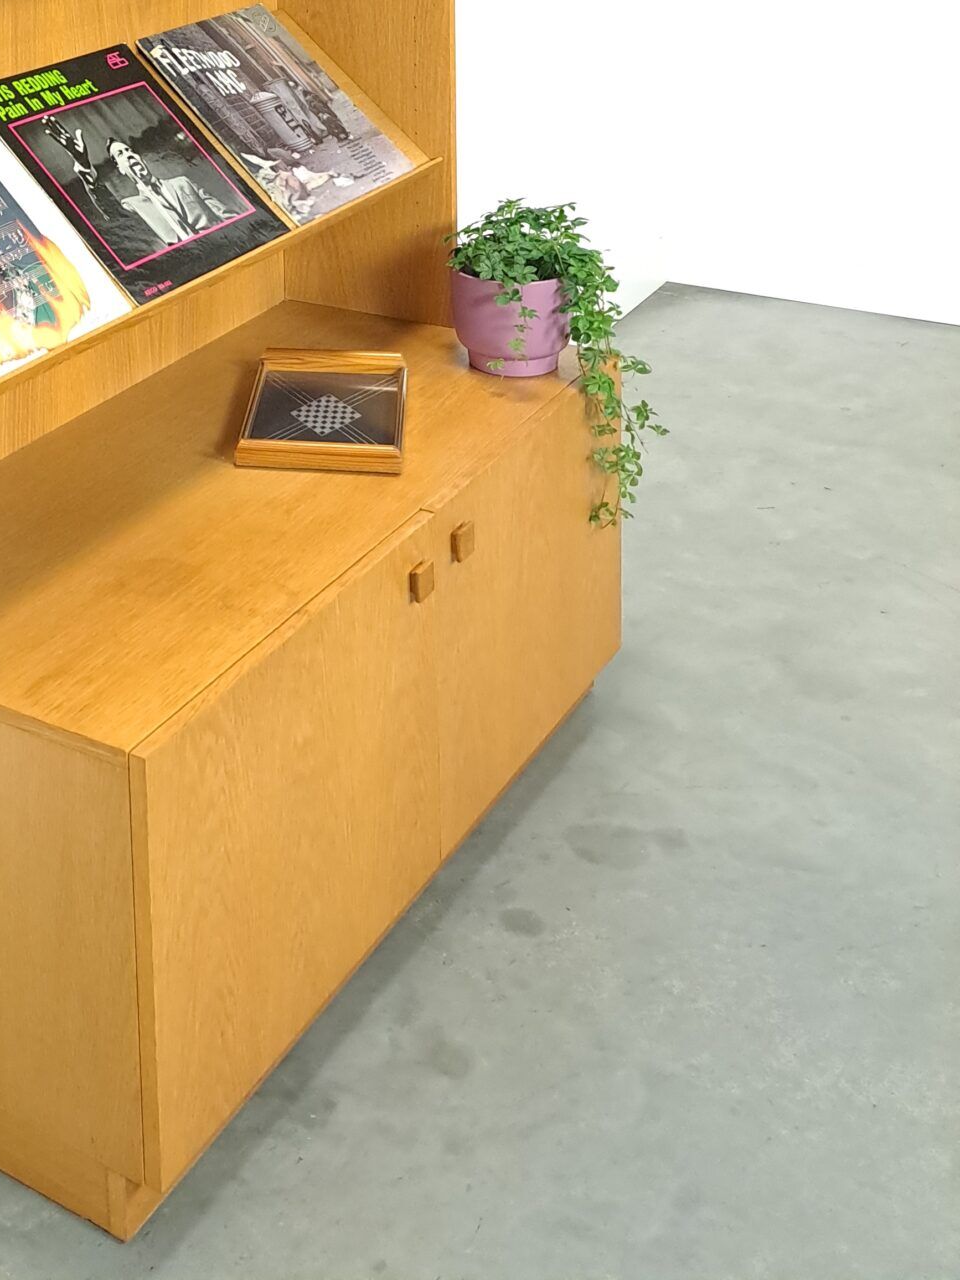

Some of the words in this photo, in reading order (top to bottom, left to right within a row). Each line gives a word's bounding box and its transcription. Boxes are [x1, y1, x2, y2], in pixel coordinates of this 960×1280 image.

[12, 70, 68, 96] REDDING
[25, 94, 45, 110] In
[41, 88, 65, 106] My
[61, 79, 98, 100] Heart
